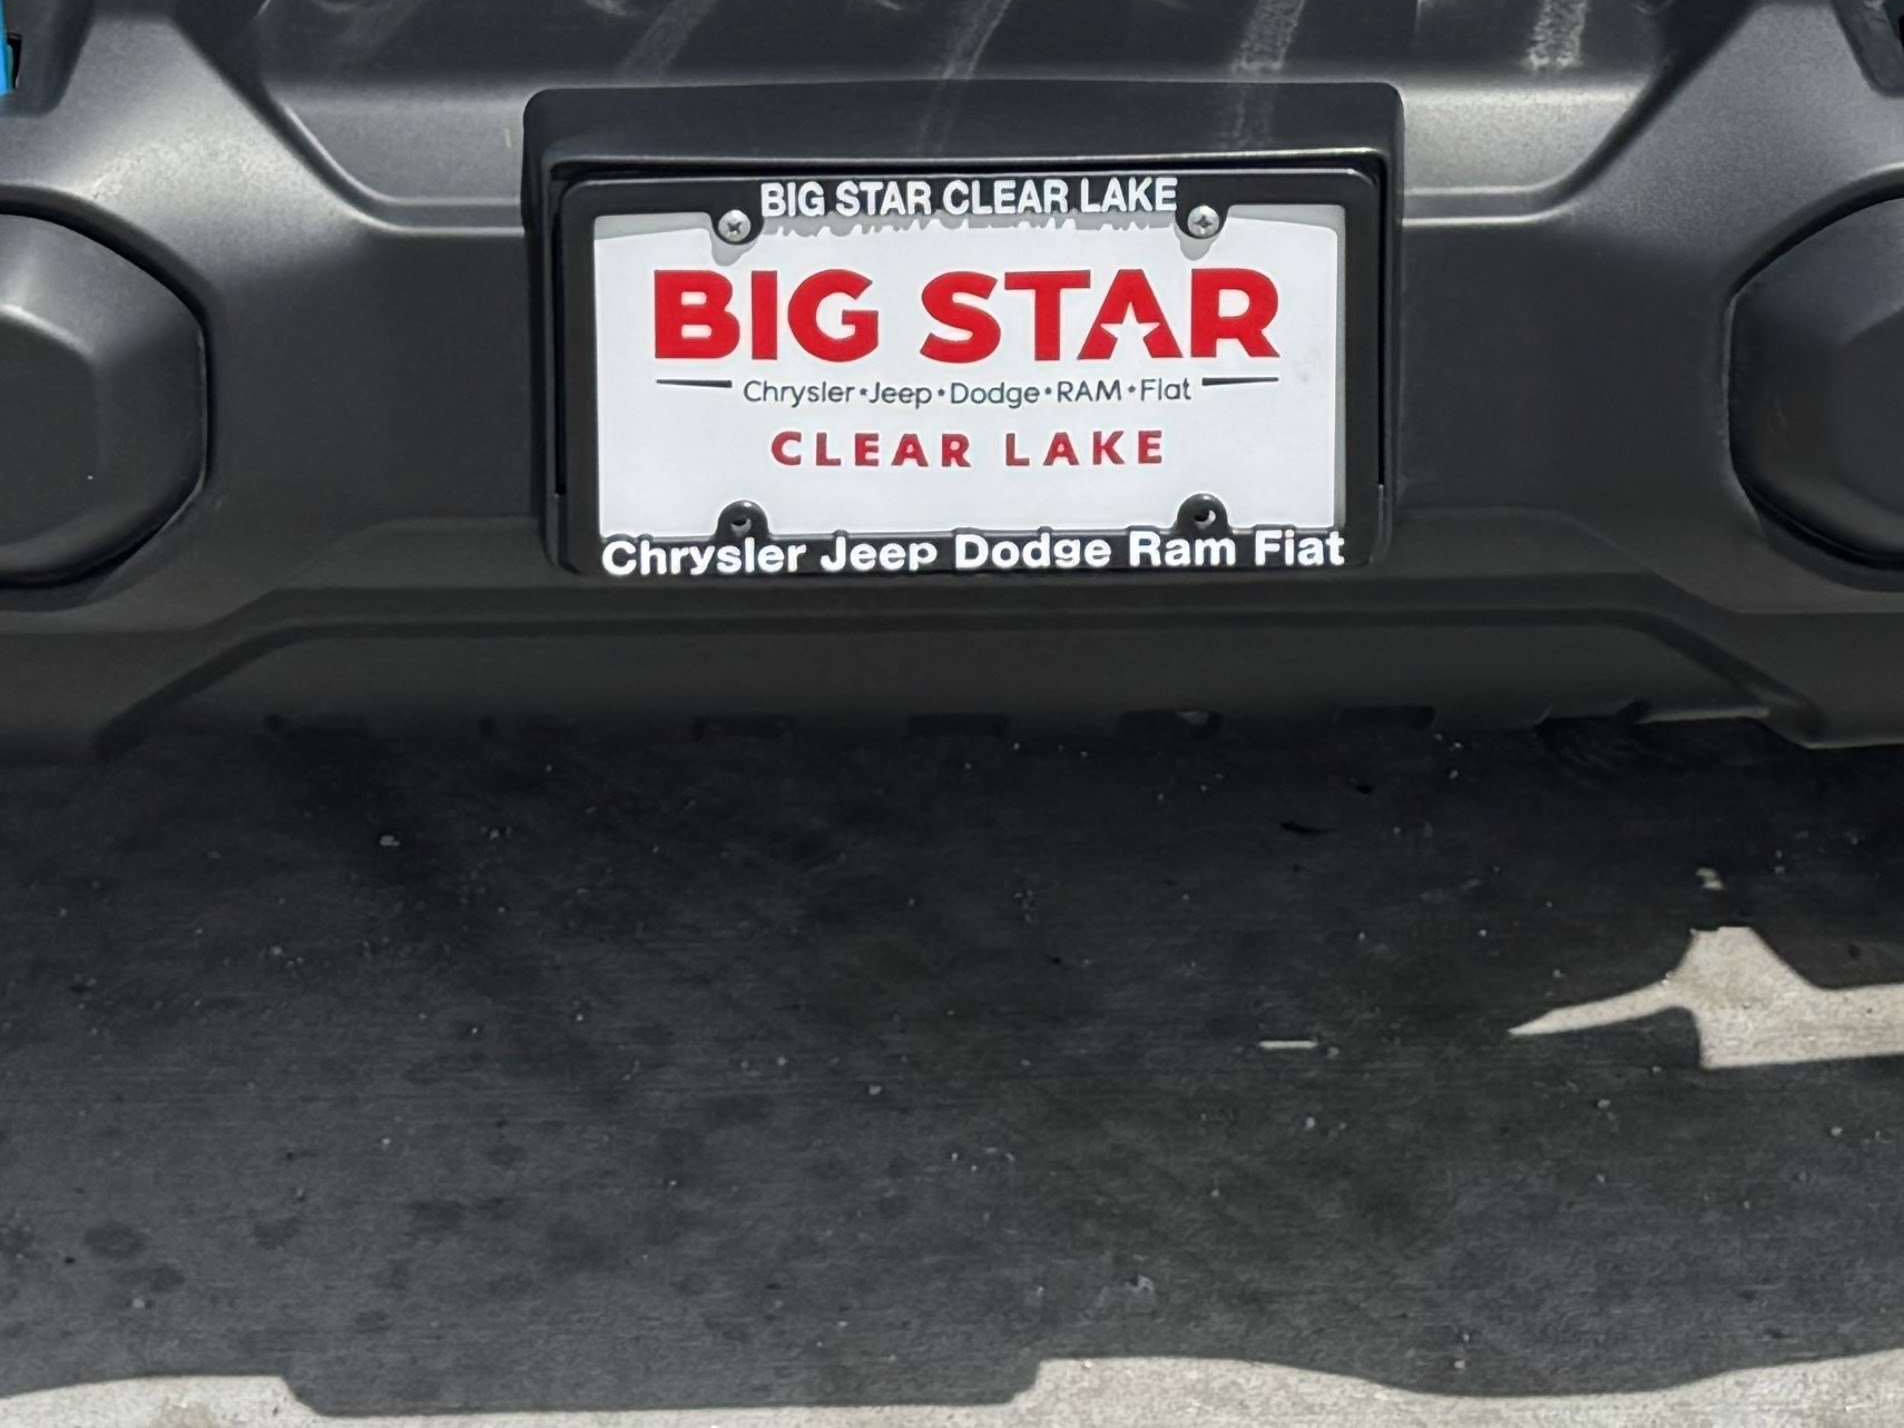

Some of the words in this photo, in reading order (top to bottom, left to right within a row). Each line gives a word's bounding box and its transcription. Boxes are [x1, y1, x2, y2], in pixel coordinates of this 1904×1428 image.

[761, 181, 825, 217] BIG
[835, 180, 932, 216] STAR
[942, 178, 1068, 215] CLEAR
[1081, 177, 1178, 212] LAKE
[654, 269, 879, 363] BIG
[920, 268, 1280, 364] STAR
[771, 431, 972, 468] CLEAR
[1005, 430, 1163, 466] LAKE
[601, 537, 807, 576] Chrysler
[820, 536, 938, 571] Jeep
[955, 531, 1112, 569] Dodge
[1129, 531, 1236, 568] Ram
[1254, 530, 1346, 566] Fiat
